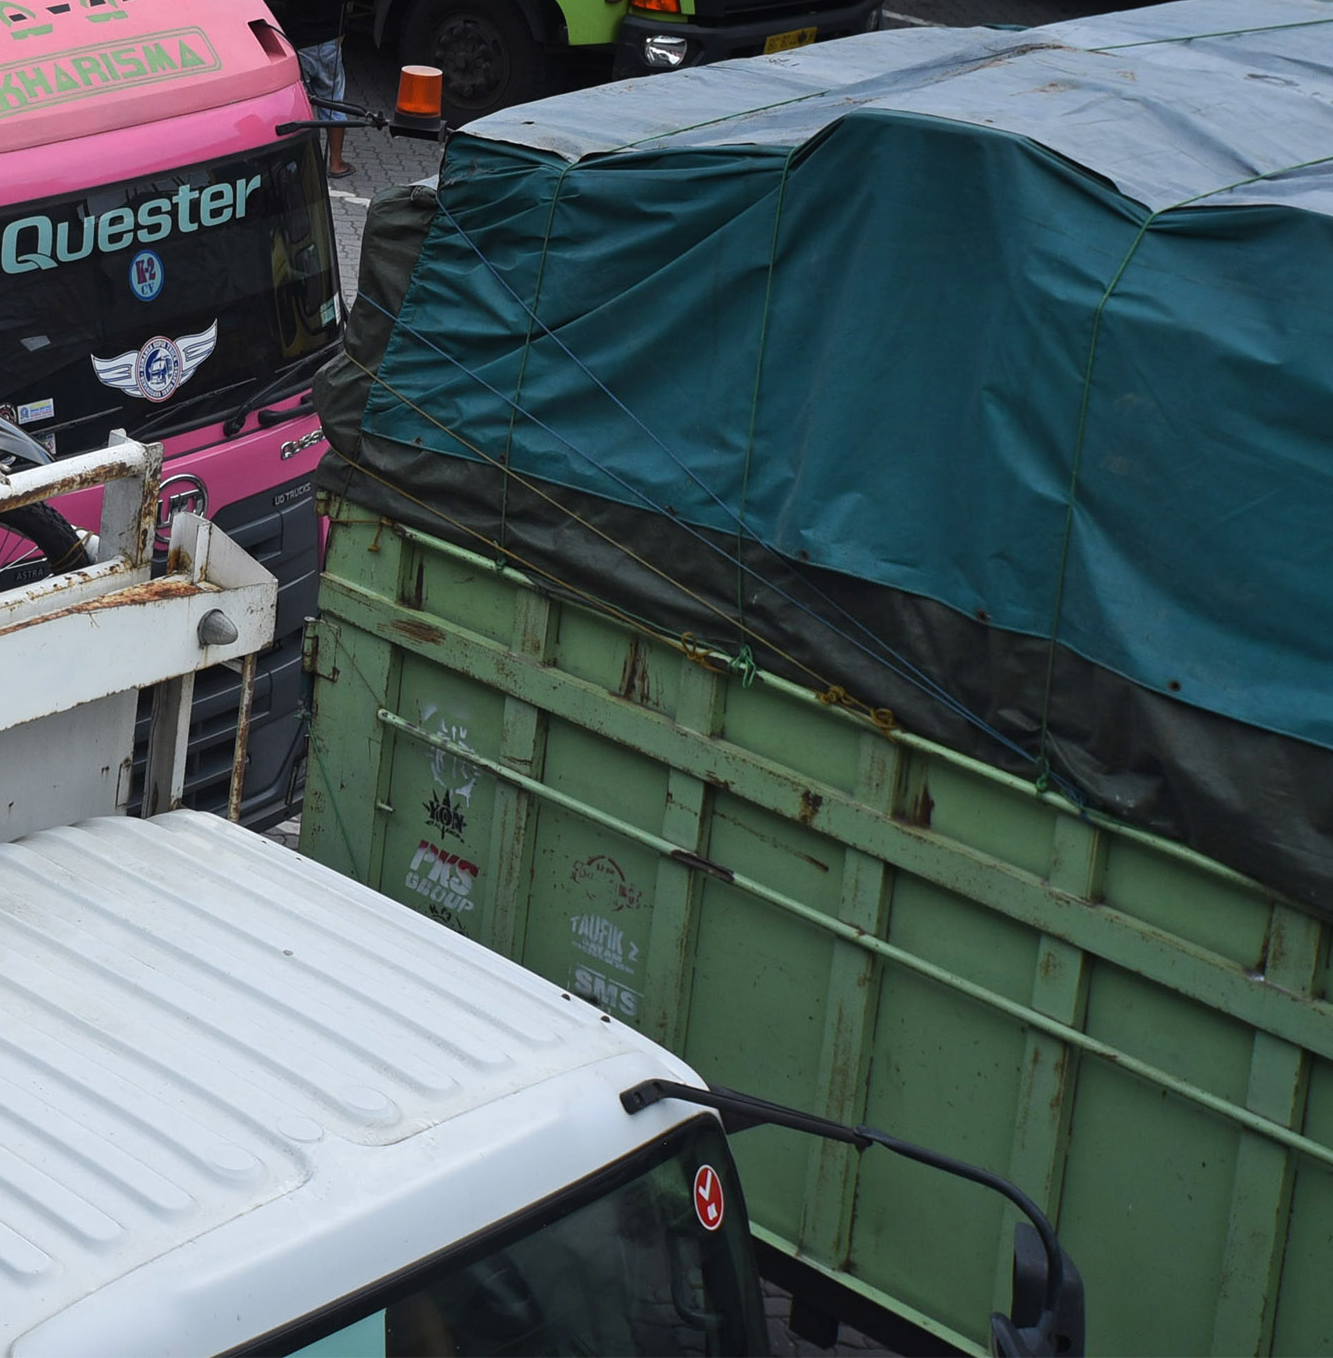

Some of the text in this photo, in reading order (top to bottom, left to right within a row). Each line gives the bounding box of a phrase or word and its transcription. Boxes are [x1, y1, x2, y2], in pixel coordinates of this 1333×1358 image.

[1, 175, 261, 274] Quester
[135, 258, 157, 285] K-2
[140, 282, 155, 297] CV
[285, 482, 312, 502] TRUCKS
[16, 568, 44, 581] ASTRA
[409, 839, 480, 895] PKS
[405, 872, 475, 913] GROUP
[570, 914, 624, 957] TAUFIK
[575, 968, 637, 1017] SMS
